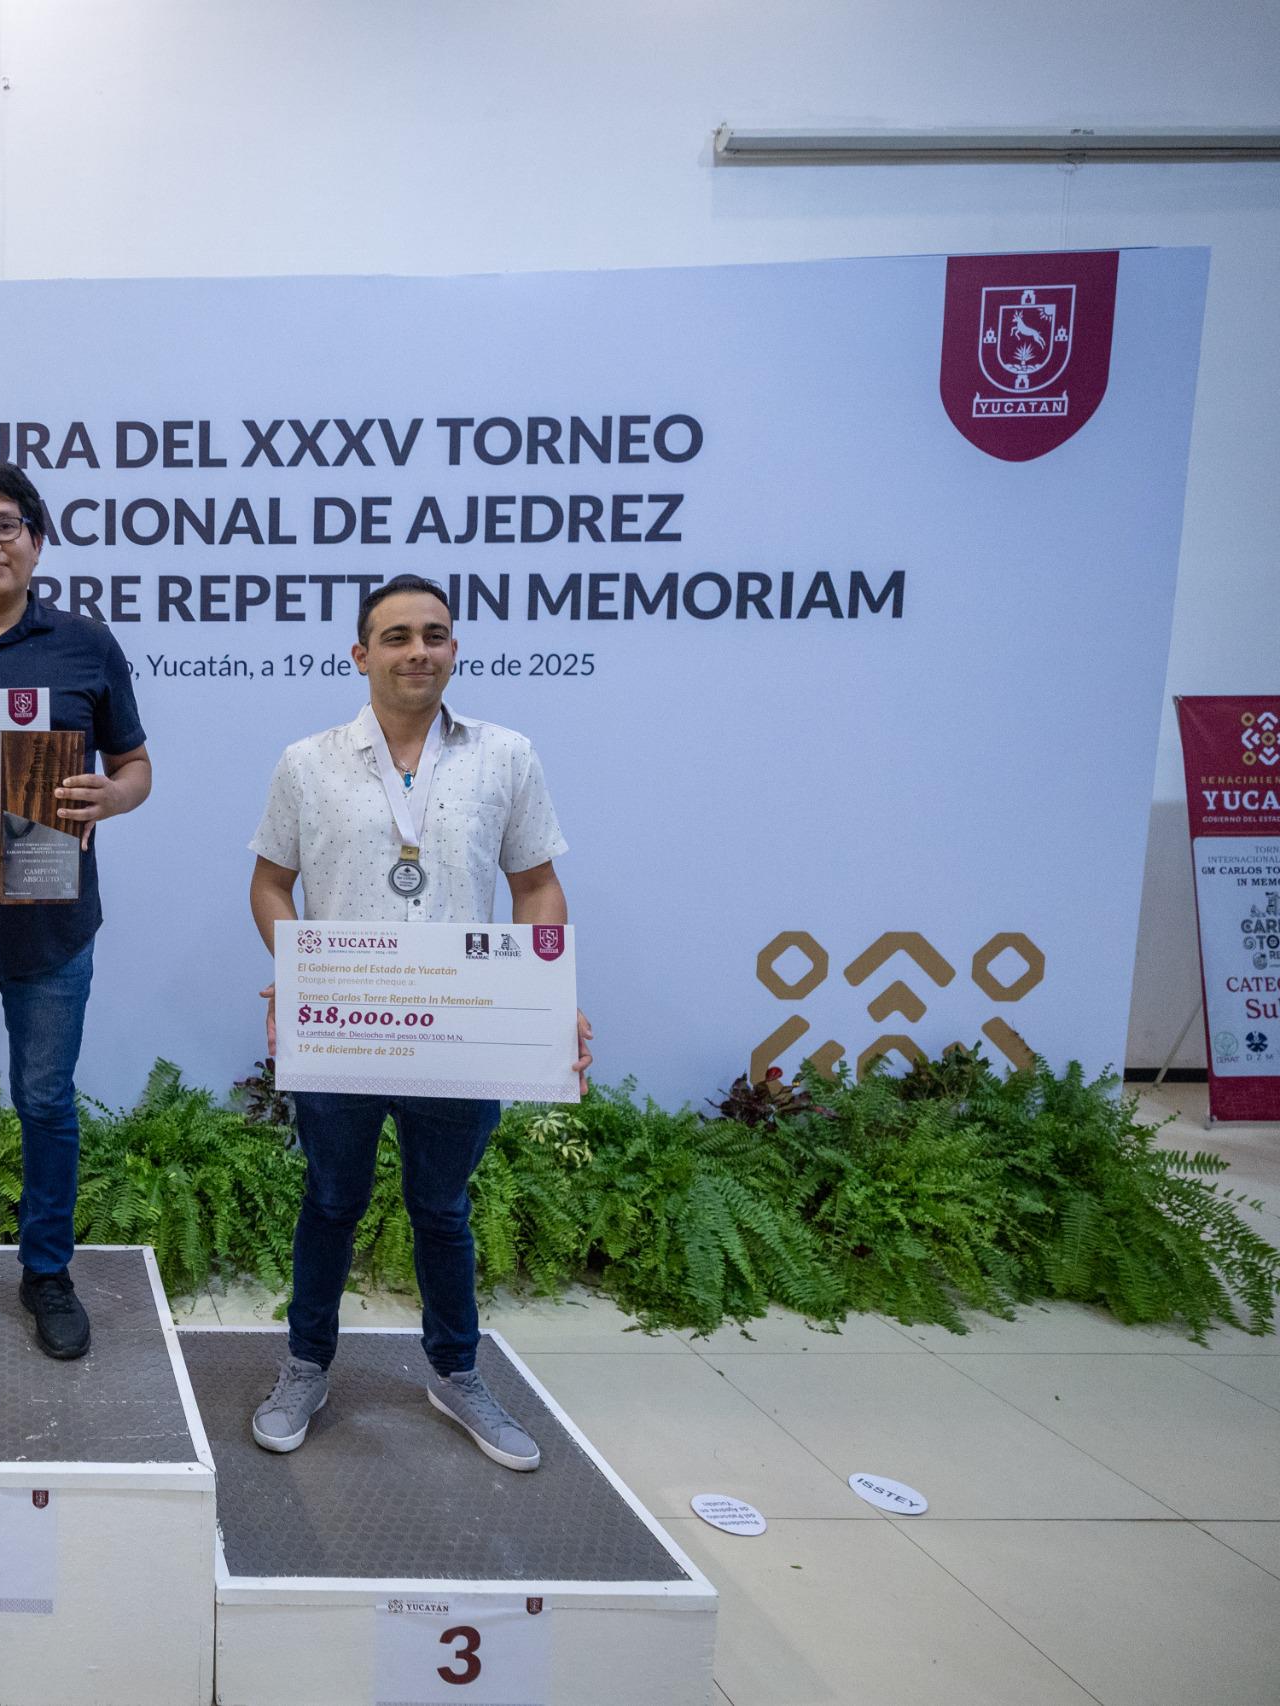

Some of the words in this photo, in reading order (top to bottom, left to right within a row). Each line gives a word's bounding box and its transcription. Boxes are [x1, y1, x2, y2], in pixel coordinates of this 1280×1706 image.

[979, 401, 1063, 413] YUCATAN
[117, 419, 226, 468] DEL
[241, 418, 420, 468] XXXV
[437, 414, 703, 466] TORNEO
[314, 497, 395, 545] DE
[402, 493, 682, 547] AJEDREZ
[158, 574, 438, 622] REPETT
[448, 573, 510, 621] IN
[526, 570, 906, 620] MEMORIAM
[147, 654, 254, 679] Yucatán,
[261, 660, 274, 676] a
[283, 654, 314, 676] 19
[321, 654, 351, 676] de
[491, 654, 522, 676] de
[529, 653, 595, 676] 2025
[1202, 790, 1280, 811] YUCA
[1208, 856, 1278, 864] INTERNACIONAL
[1201, 866, 1215, 875] GM
[1220, 866, 1262, 875] CARLOS
[1265, 866, 1280, 874] TO
[1237, 878, 1247, 887] IN
[328, 936, 398, 949] YUCATÁN
[298, 963, 306, 972] El
[308, 963, 351, 973] Gobierno
[353, 964, 367, 973] del
[370, 965, 401, 974] Estado
[404, 965, 416, 974] de
[418, 965, 457, 976] Yucatán
[298, 976, 326, 985] Otorga
[338, 978, 373, 986] presente
[375, 977, 406, 987] cheque
[1226, 977, 1280, 992] CATE
[298, 992, 330, 1001] Torneo
[331, 992, 360, 1002] Carlos
[364, 993, 387, 1002] Torre
[390, 994, 426, 1005] Repetto
[429, 995, 438, 1004] In
[440, 996, 493, 1005] Memoriam
[1245, 998, 1280, 1019] Su
[298, 1004, 434, 1028] $18,000.00
[306, 1029, 335, 1037] cantidad
[349, 1031, 383, 1039] Dieciocho
[418, 1033, 445, 1041] 00/100
[298, 1044, 310, 1053] 19
[312, 1044, 324, 1053] de
[326, 1044, 373, 1055] diciembre
[375, 1045, 386, 1055] de
[389, 1047, 415, 1057] 2025
[856, 1477, 920, 1508] ISSTEY
[437, 1625, 481, 1685] 3
